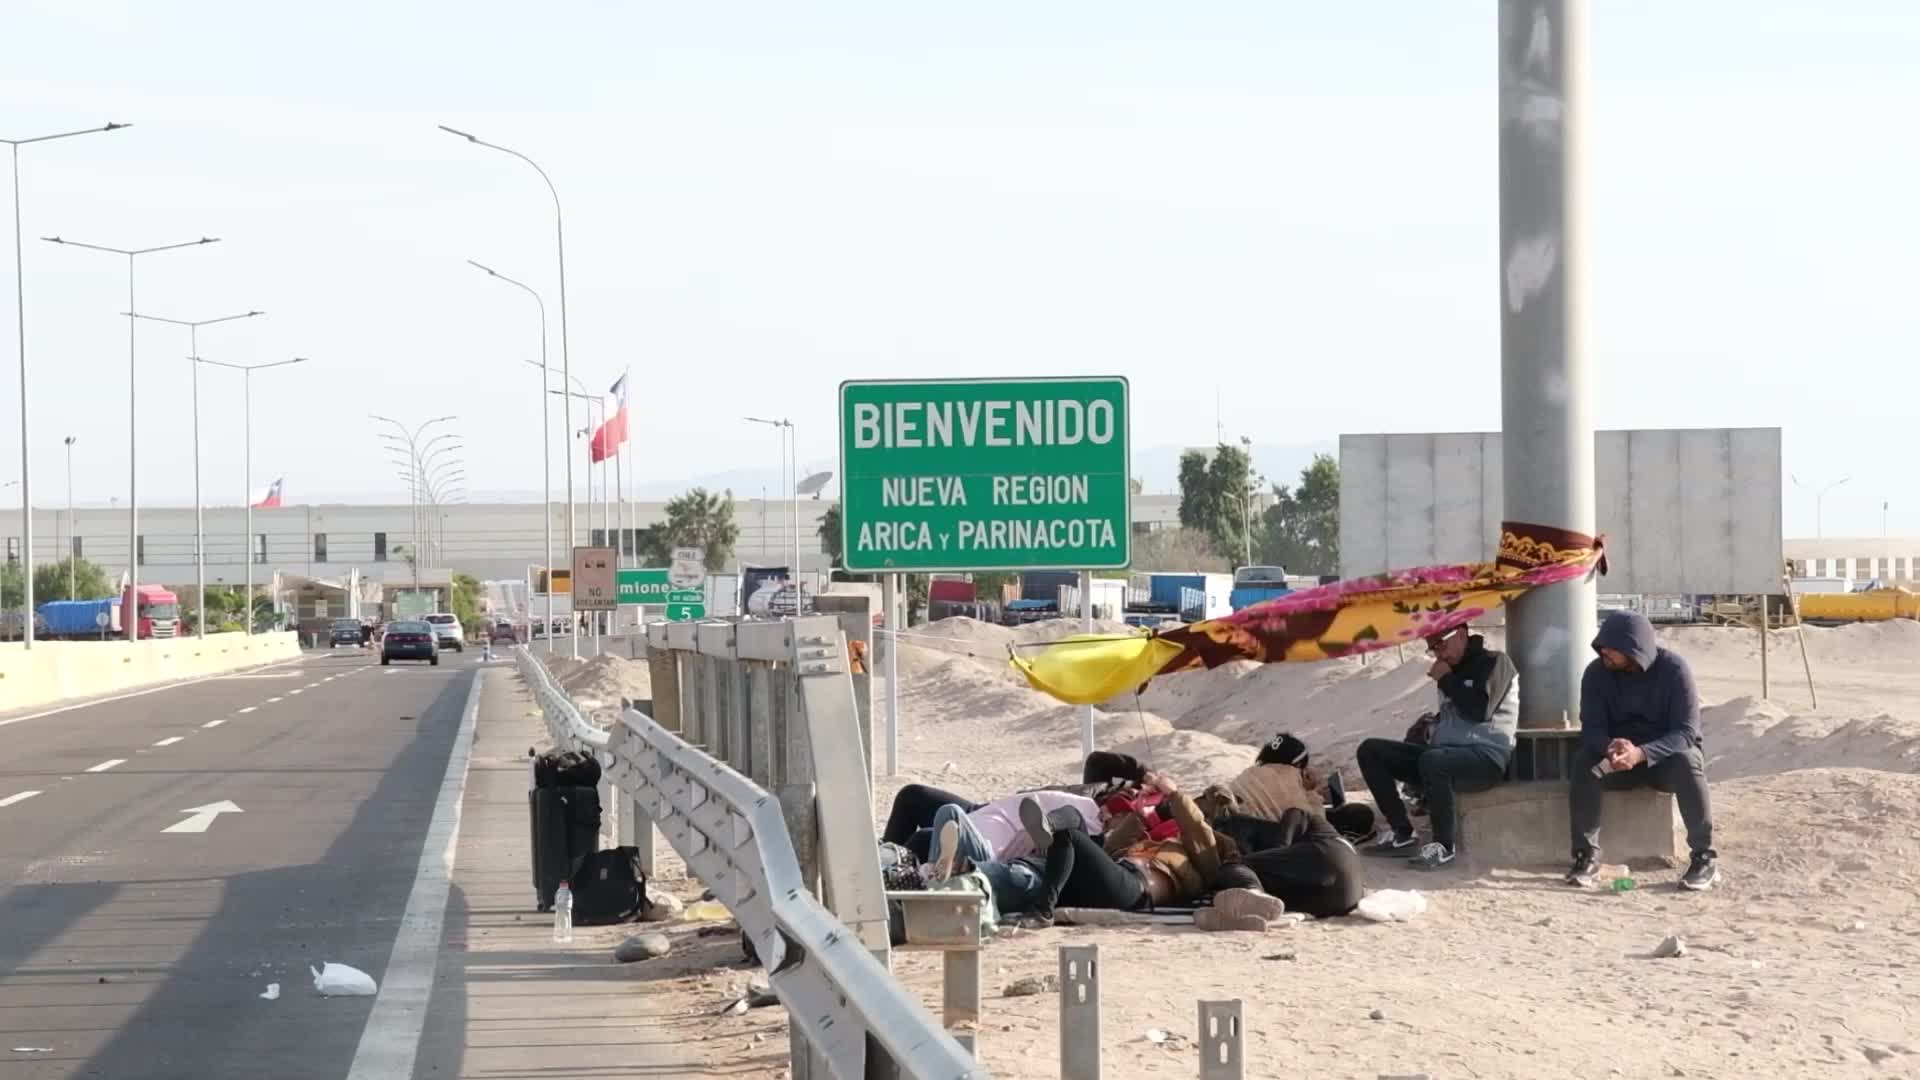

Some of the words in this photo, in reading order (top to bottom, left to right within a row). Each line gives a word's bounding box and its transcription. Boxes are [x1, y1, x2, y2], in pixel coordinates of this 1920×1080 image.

[854, 399, 1114, 449] BIENVENIDO
[882, 476, 967, 507] NUEVA
[993, 474, 1089, 505] REGION
[857, 521, 933, 551] ARICA
[958, 518, 1116, 550] PARINACOTA
[589, 587, 601, 597] NO
[620, 581, 677, 594] mione
[681, 607, 692, 620] 5
